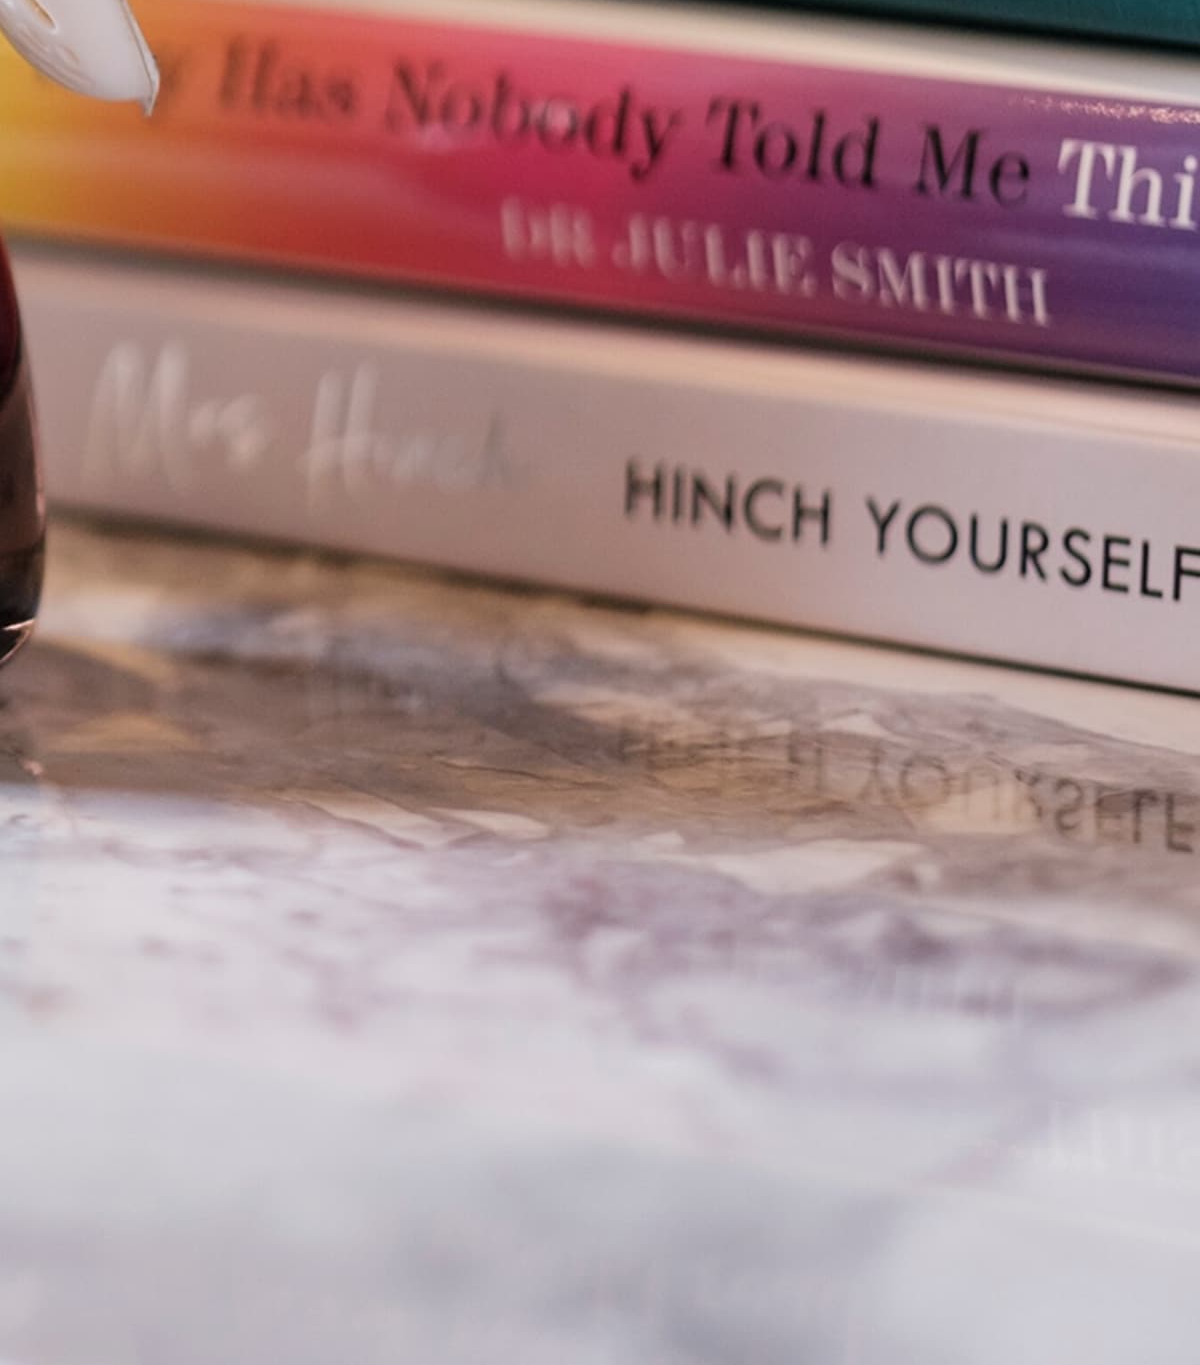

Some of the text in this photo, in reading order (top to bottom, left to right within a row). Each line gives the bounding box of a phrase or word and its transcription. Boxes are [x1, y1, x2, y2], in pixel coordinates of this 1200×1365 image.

[216, 33, 356, 118] Has
[384, 57, 683, 183] Nobody
[704, 94, 881, 191] Told
[914, 122, 1032, 204] Me
[1057, 137, 1198, 232] Thi
[501, 193, 1050, 328] DR JULIE SMITH
[623, 455, 1200, 603] HINCH YOURSELF
